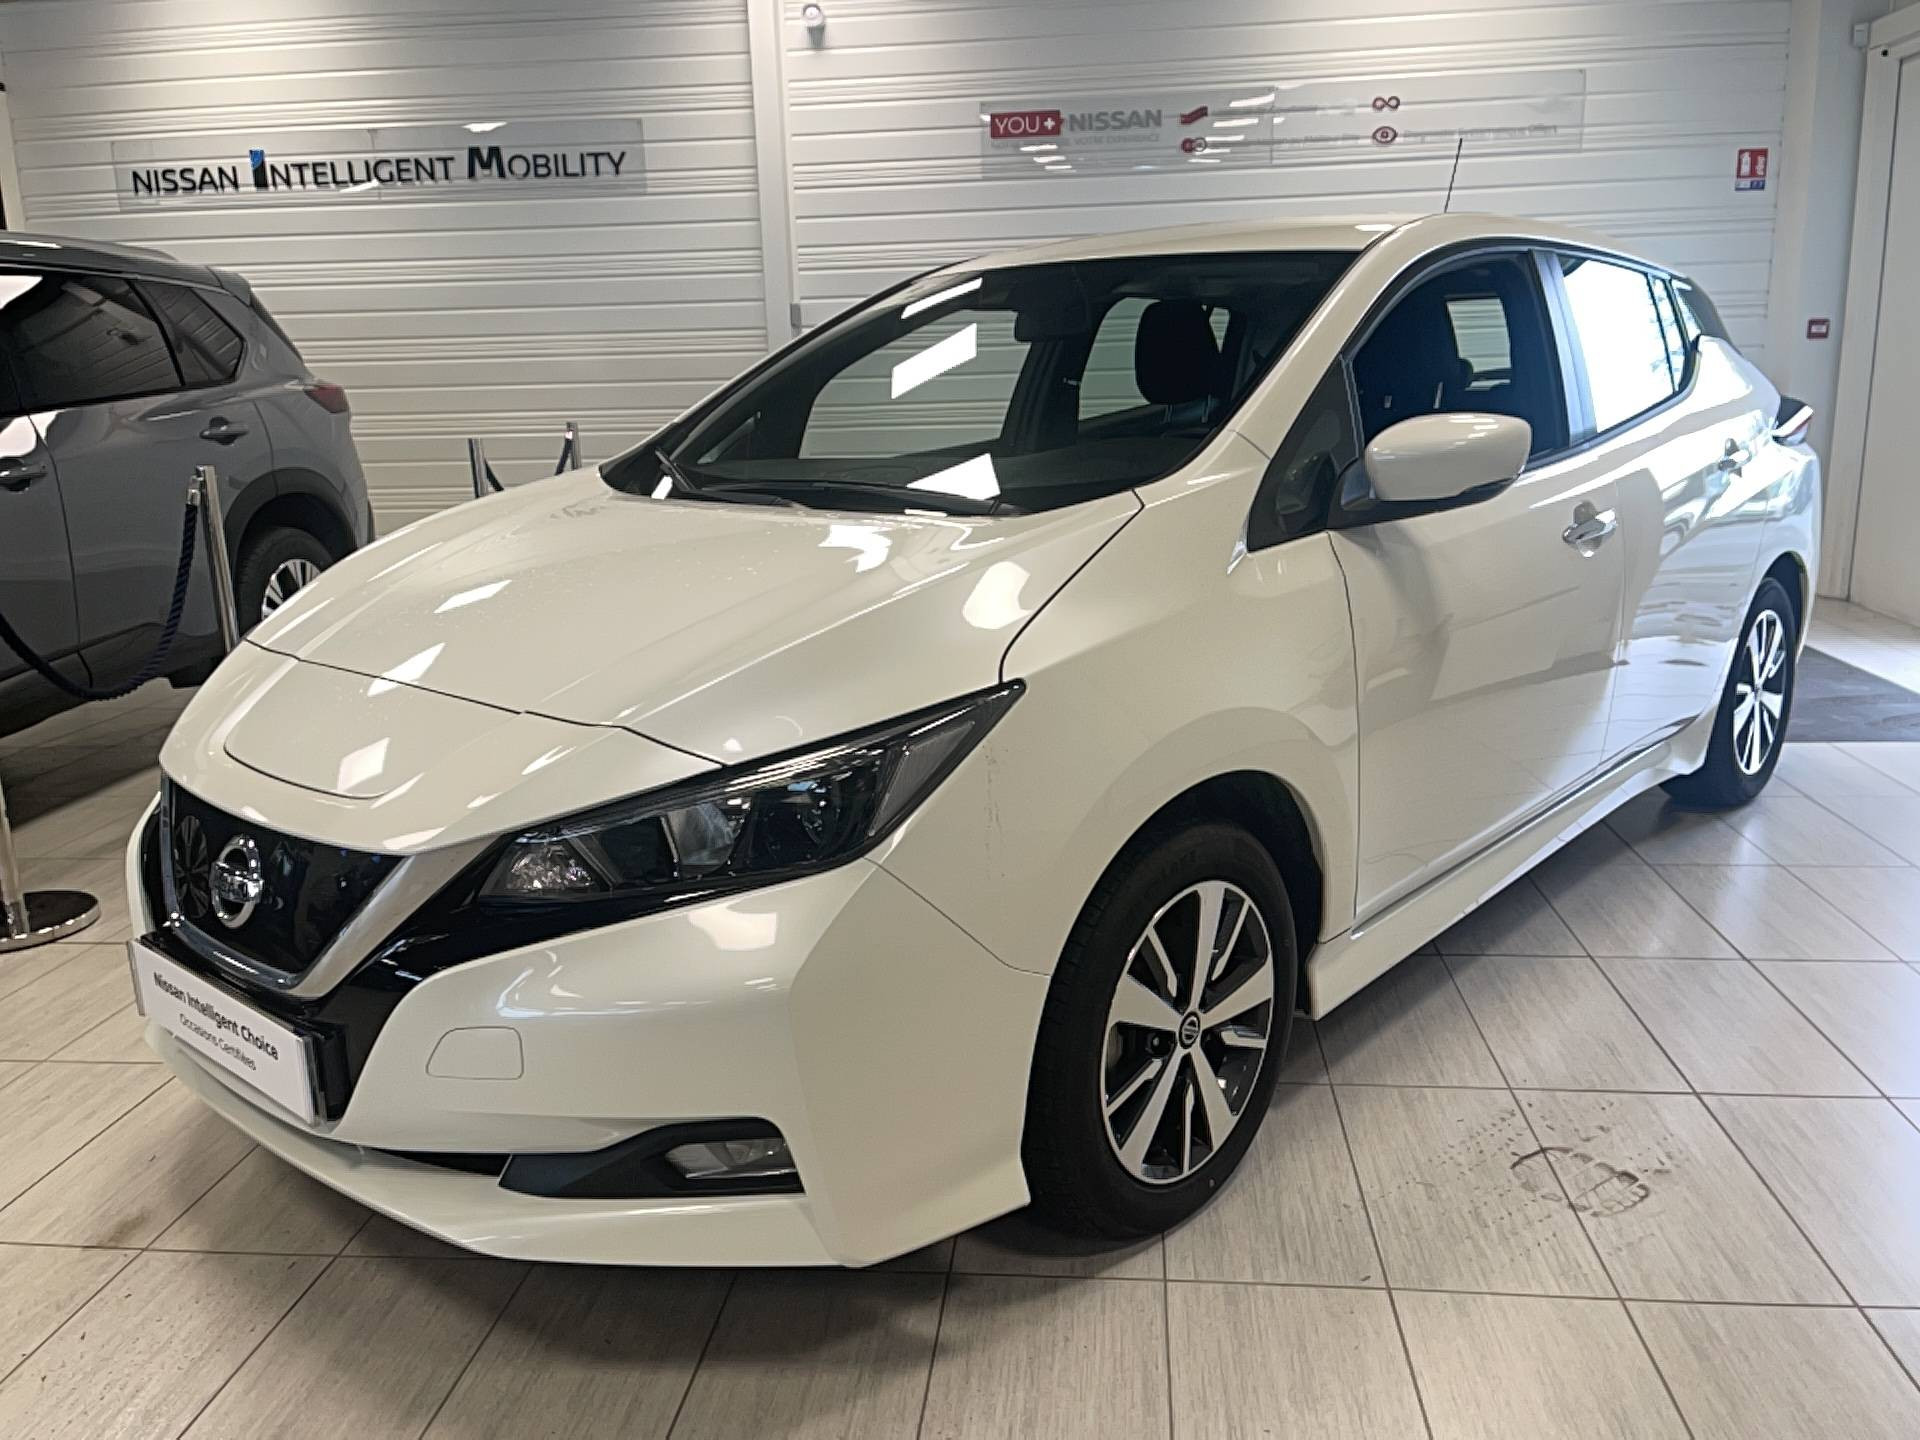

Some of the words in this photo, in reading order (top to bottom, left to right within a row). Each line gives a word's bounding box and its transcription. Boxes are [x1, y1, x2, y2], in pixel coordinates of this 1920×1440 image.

[1069, 110, 1162, 131] NISSAN
[131, 166, 240, 196] NISSAN
[248, 149, 455, 189] INTELLIGENT
[466, 145, 628, 180] MOBILITY
[153, 972, 185, 1002] Nissan
[186, 992, 239, 1036] Intelligent
[240, 1025, 279, 1061] Choice
